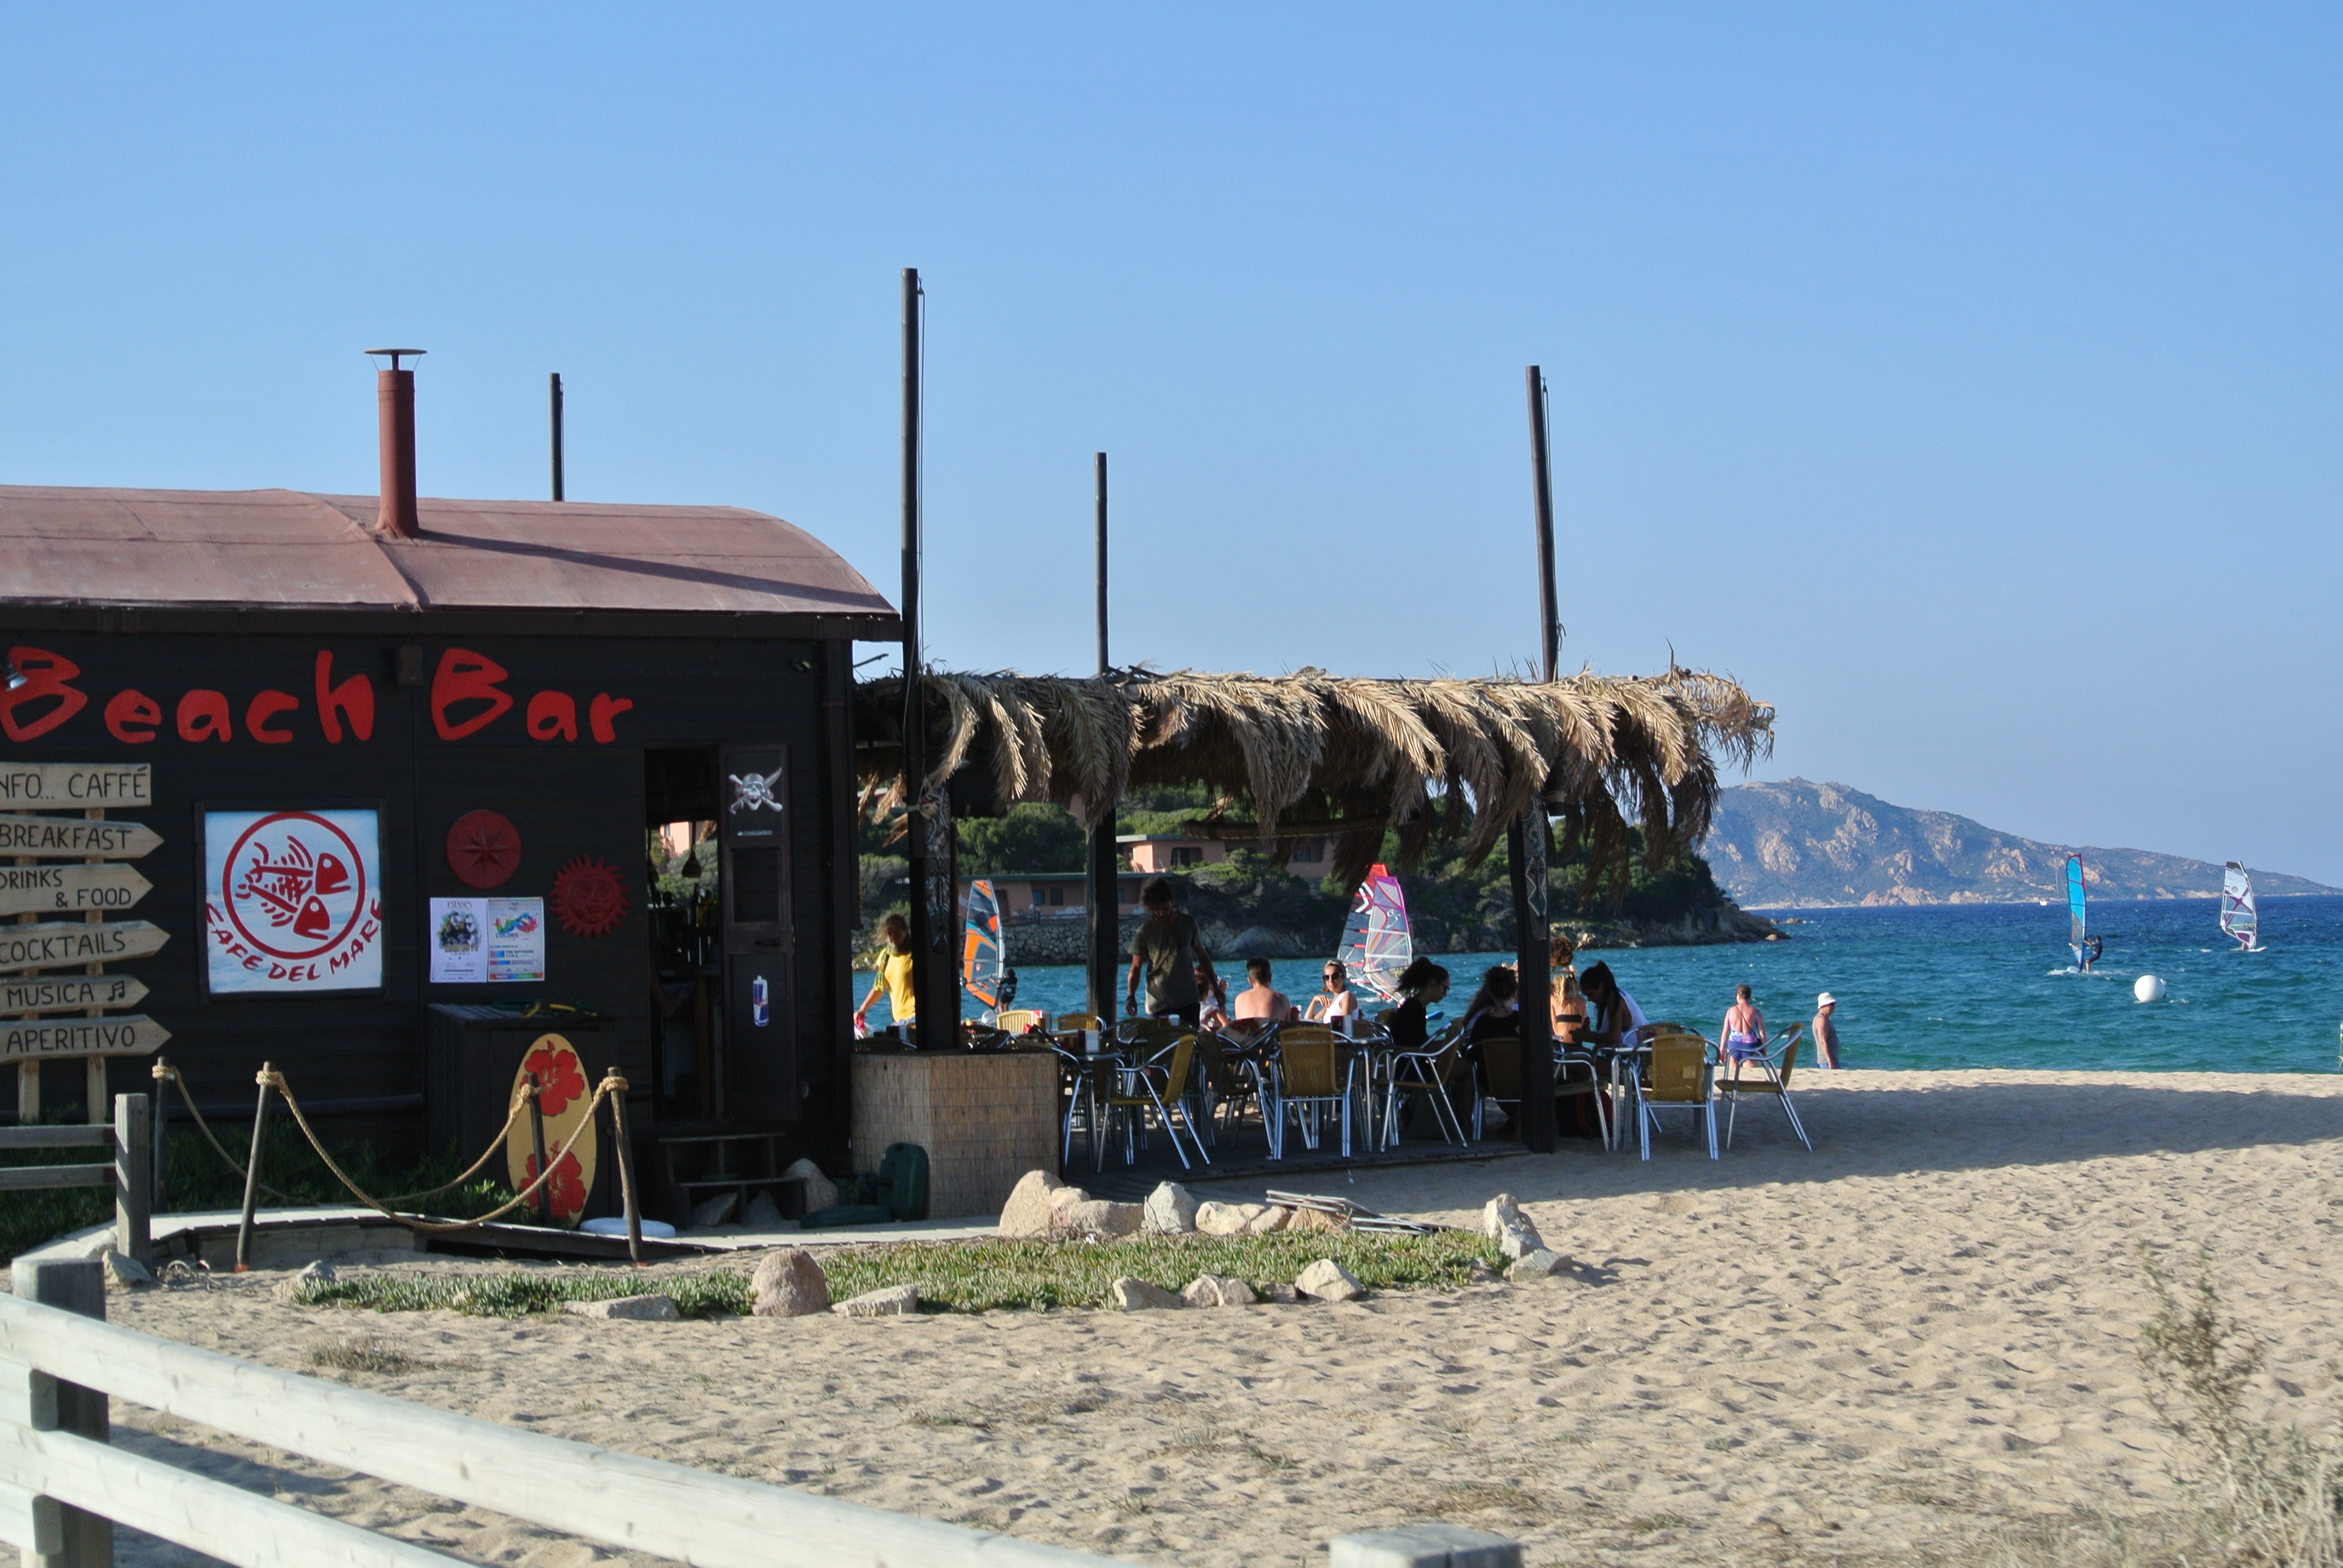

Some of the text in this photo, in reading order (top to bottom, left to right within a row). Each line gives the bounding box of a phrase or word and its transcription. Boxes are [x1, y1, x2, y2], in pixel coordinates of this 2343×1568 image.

[2, 646, 633, 743] Beach Bar
[68, 766, 147, 798] CAFFÉ
[0, 823, 132, 850] BREAKFAST
[0, 869, 63, 889] DRINKS
[55, 888, 131, 907] & FOOD
[0, 931, 125, 964] COCKTAILS
[267, 962, 321, 981] DEL
[7, 982, 94, 1007] MUSICA
[7, 1026, 135, 1054] APERITIVO
